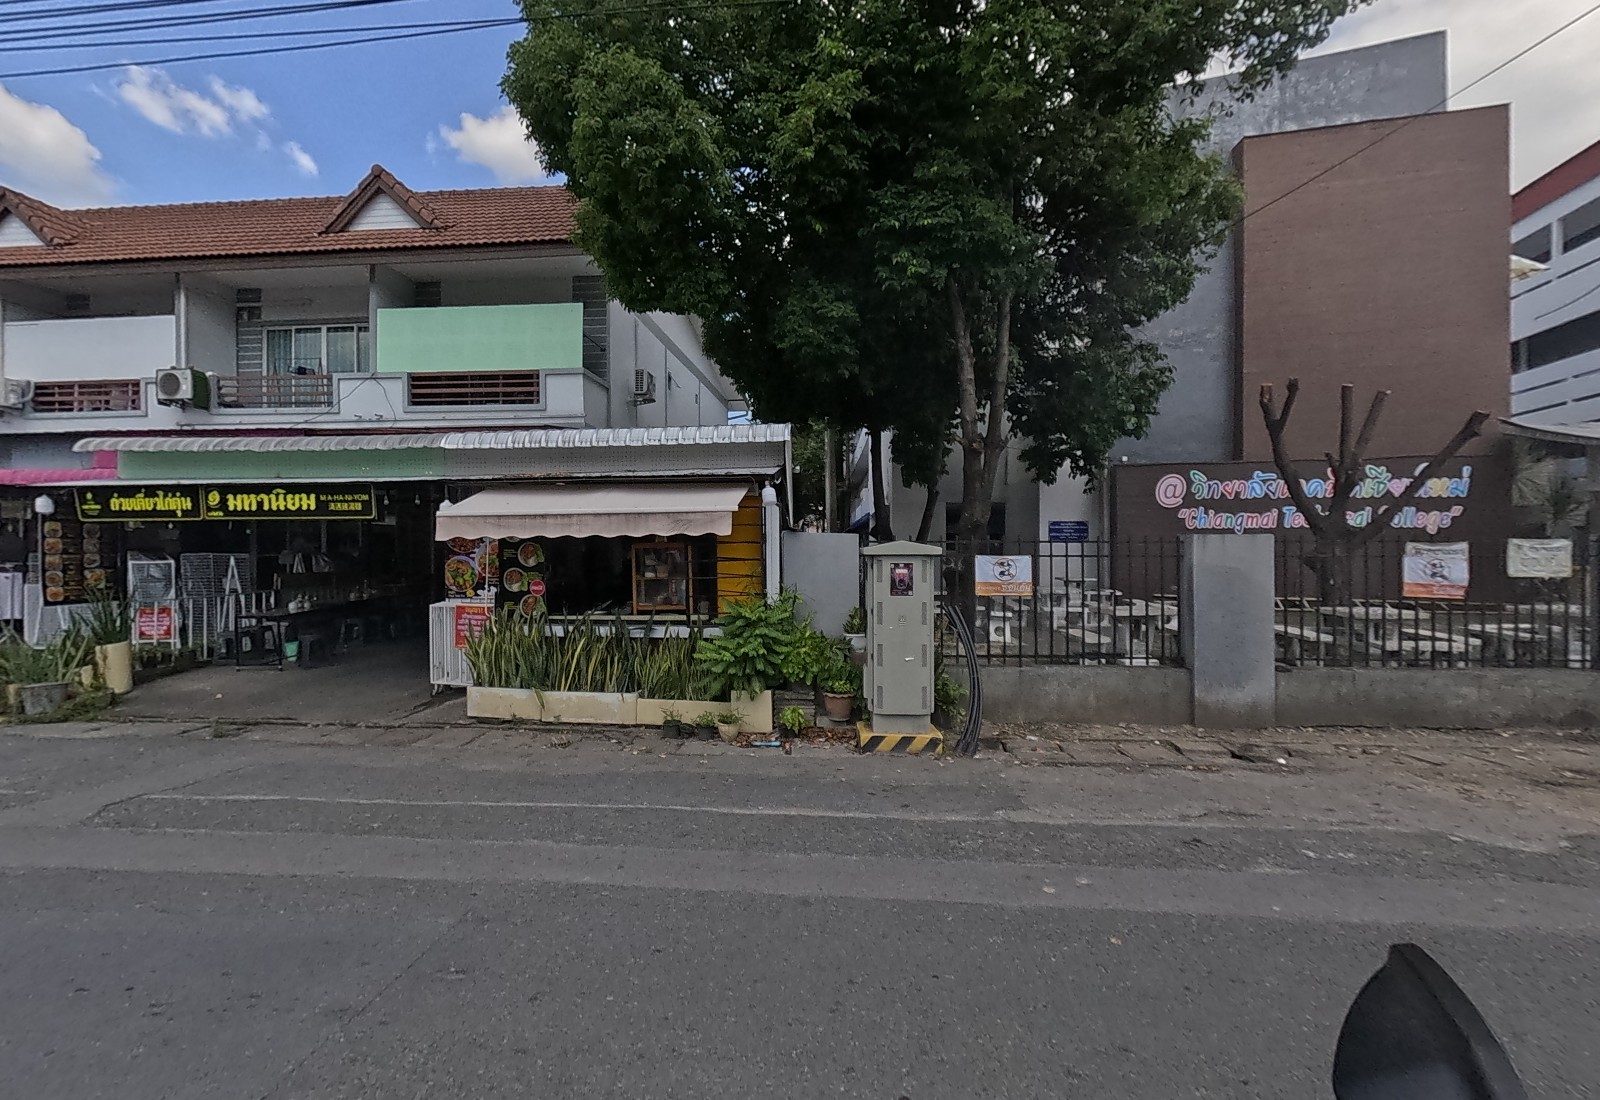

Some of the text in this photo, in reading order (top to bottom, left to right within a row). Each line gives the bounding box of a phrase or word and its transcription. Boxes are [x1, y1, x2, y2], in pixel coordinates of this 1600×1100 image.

[226, 488, 316, 511] มหานิยม
[1177, 506, 1279, 535] "Chiangmai
